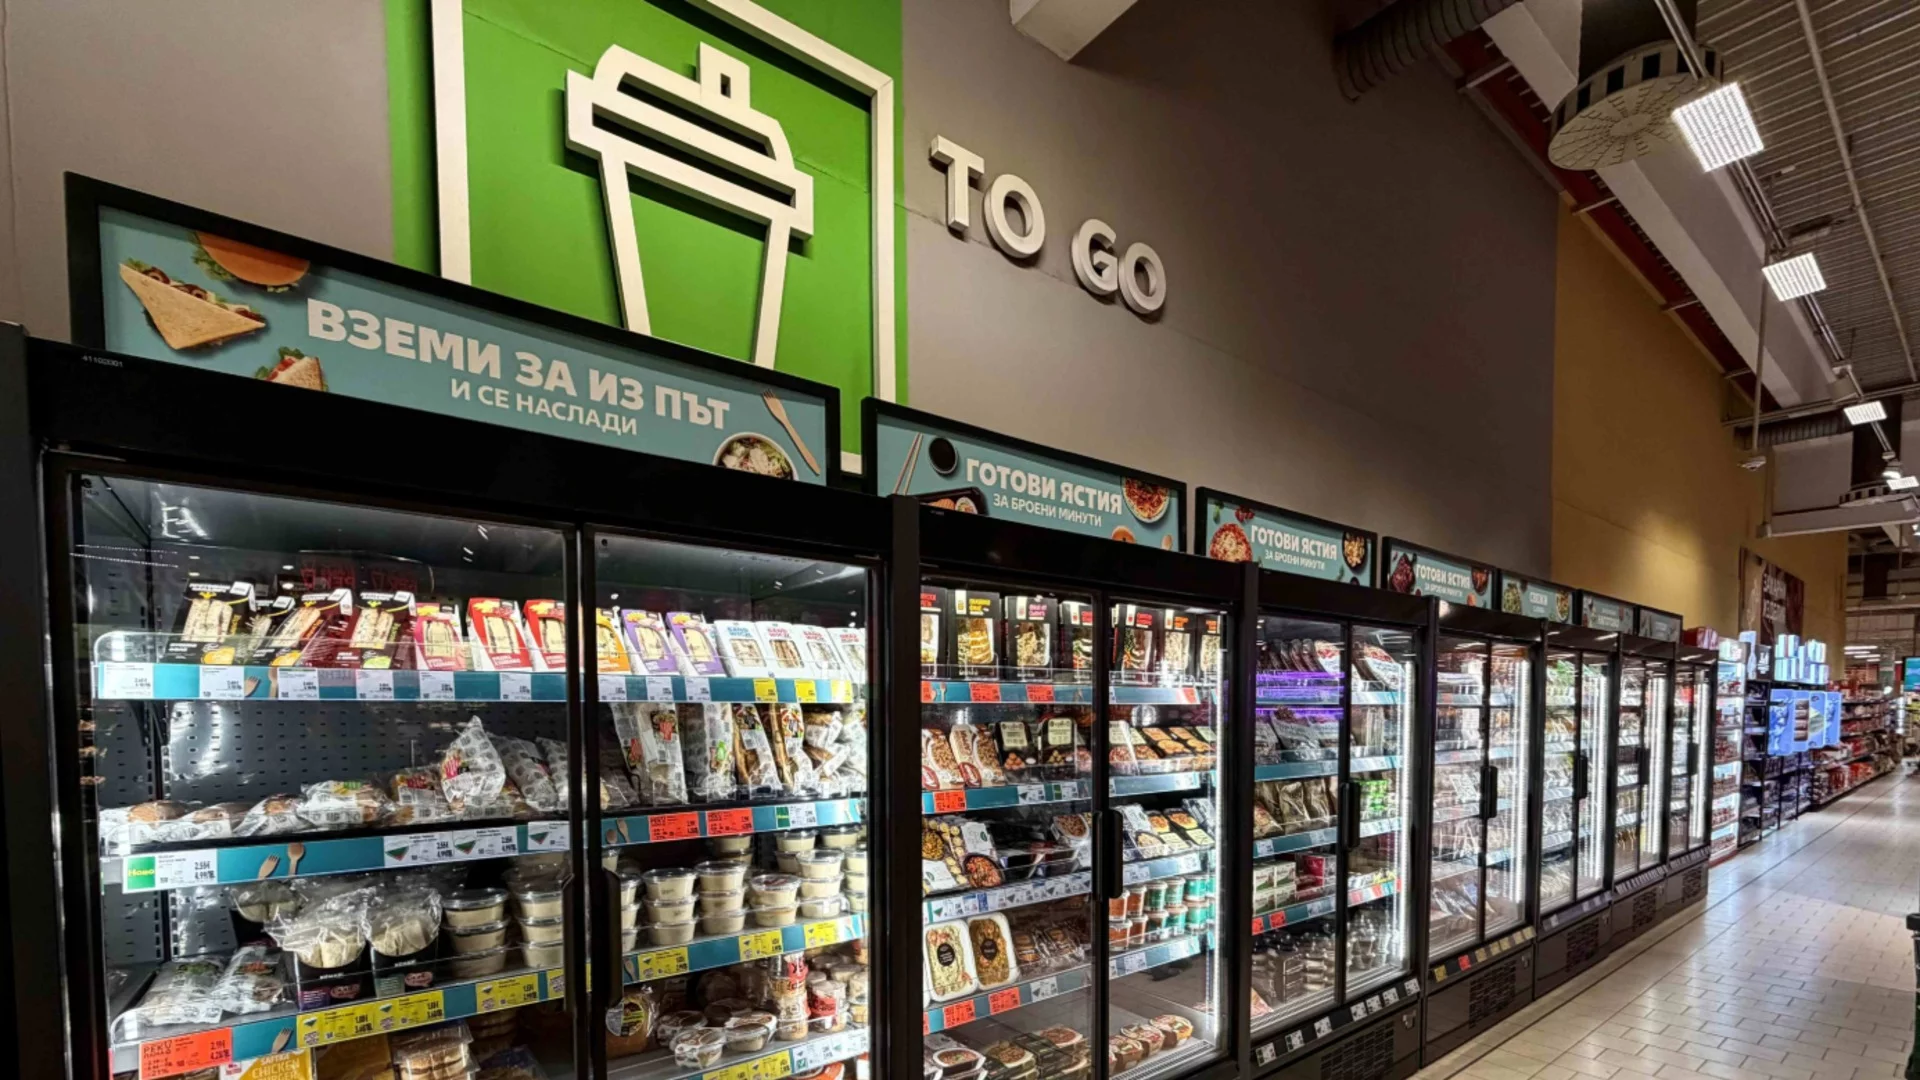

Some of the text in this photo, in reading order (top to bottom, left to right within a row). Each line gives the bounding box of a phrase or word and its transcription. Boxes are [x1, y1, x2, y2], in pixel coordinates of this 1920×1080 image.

[931, 134, 1166, 314] TO GO
[307, 297, 730, 429] ВЗЕМИ ЗА ИЗ ПЪТ
[451, 378, 637, 436] И СЕ НАСЛАДИ
[966, 457, 1123, 515] ГОТОВИ ЯСТИЯ
[993, 493, 1102, 528] ЗА БРОЕНИ МИНУТИ
[1251, 524, 1338, 561] ГОТОВИ ЯСТИЯ
[252, 1057, 300, 1080] CHICKEN
